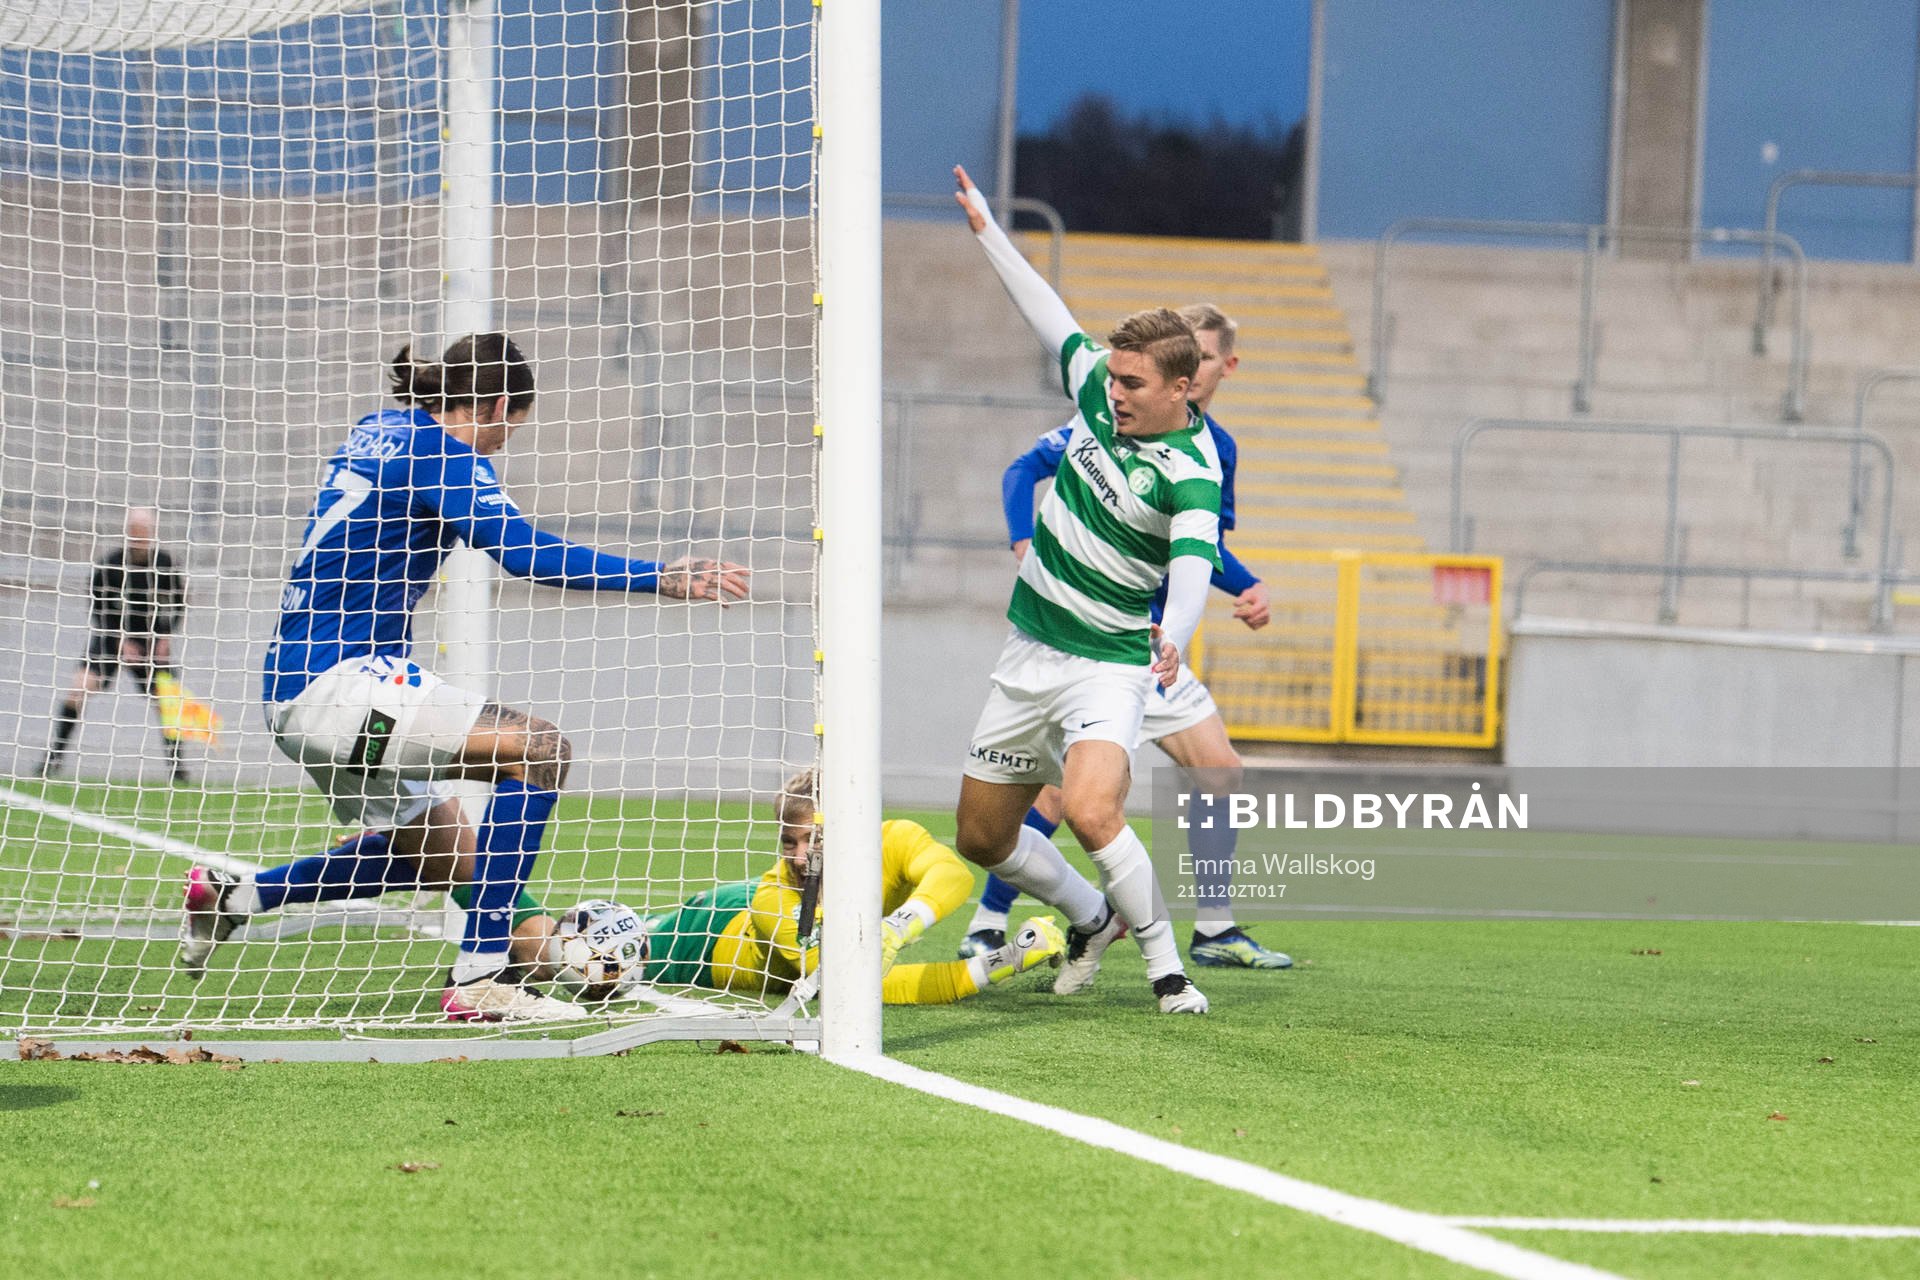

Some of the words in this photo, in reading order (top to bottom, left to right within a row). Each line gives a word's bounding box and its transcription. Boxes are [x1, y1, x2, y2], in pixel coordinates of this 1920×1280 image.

[1072, 437, 1126, 513] Kinnarps
[967, 742, 1035, 770] LKEMIT
[593, 916, 639, 945] SELECT
